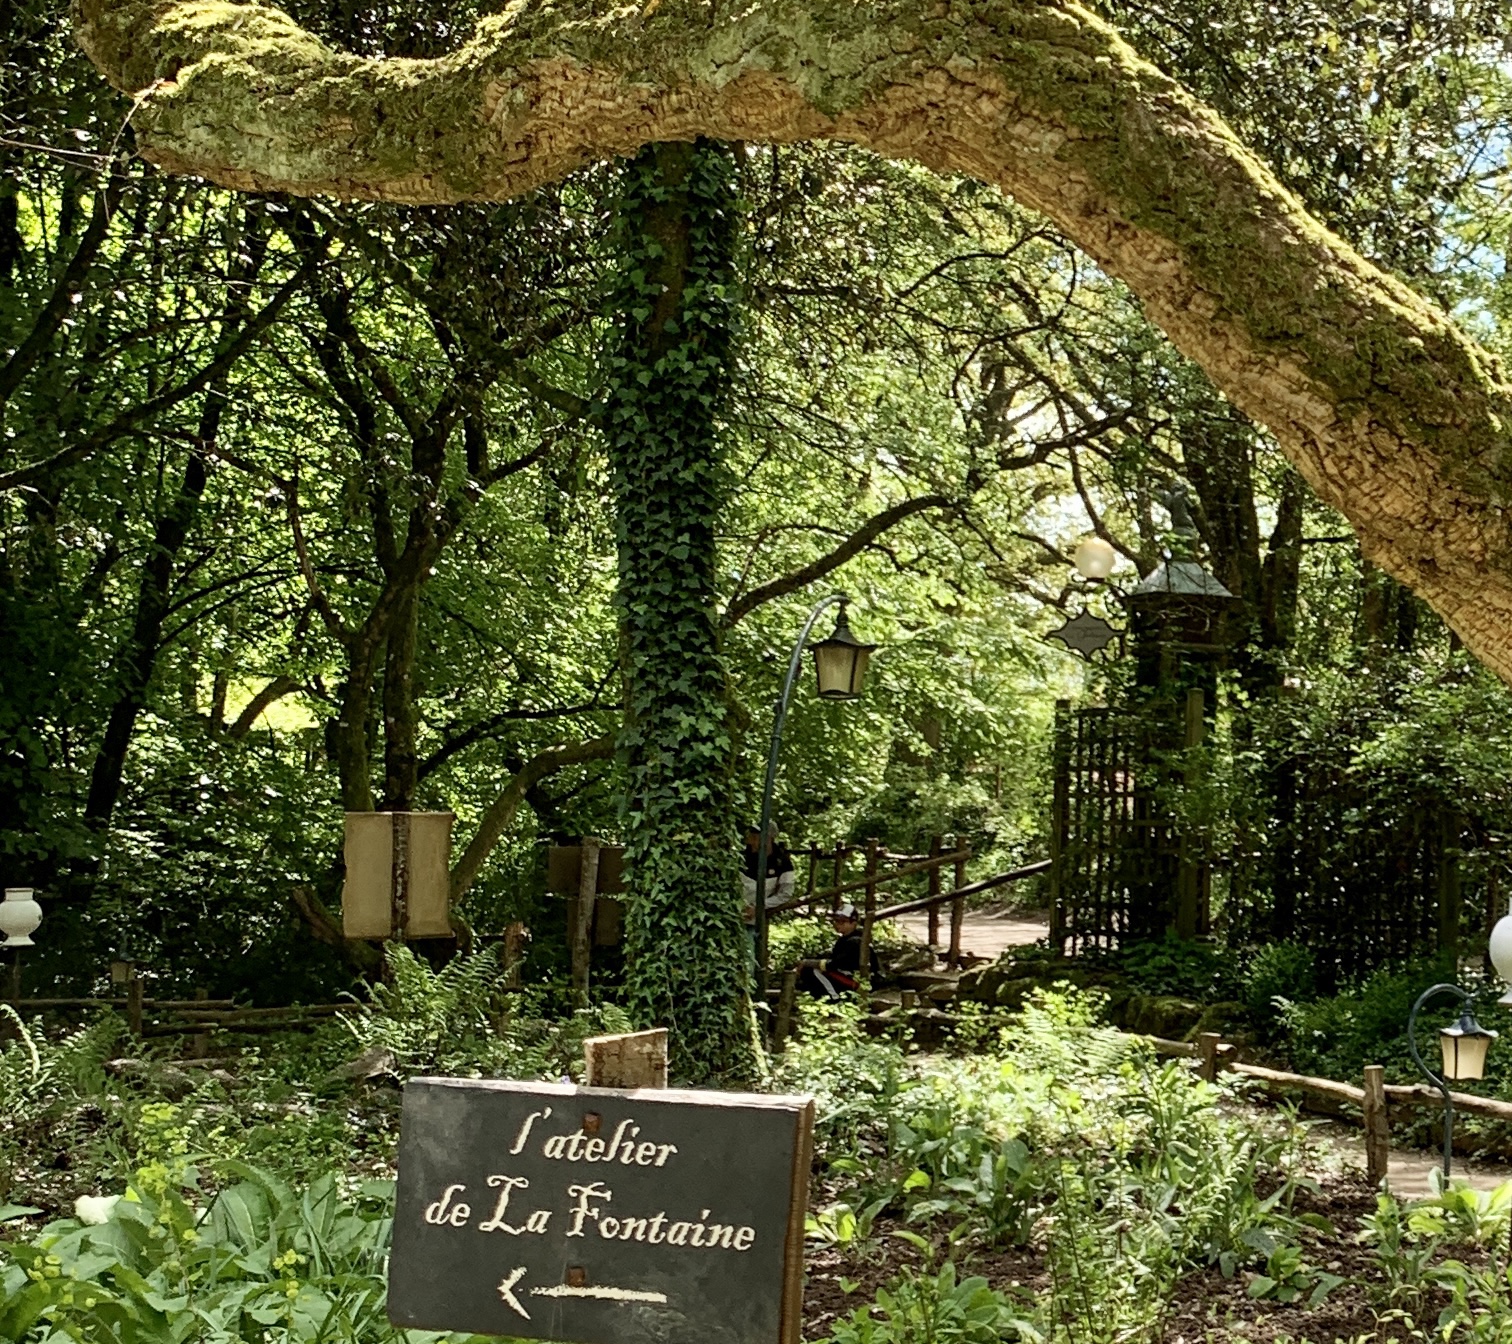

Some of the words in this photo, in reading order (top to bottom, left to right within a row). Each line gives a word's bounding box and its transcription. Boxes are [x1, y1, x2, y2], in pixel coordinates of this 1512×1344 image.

[509, 1106, 679, 1168] l'atelier
[424, 1183, 472, 1227] de
[478, 1174, 553, 1236] La
[565, 1181, 756, 1251] Fontaine
